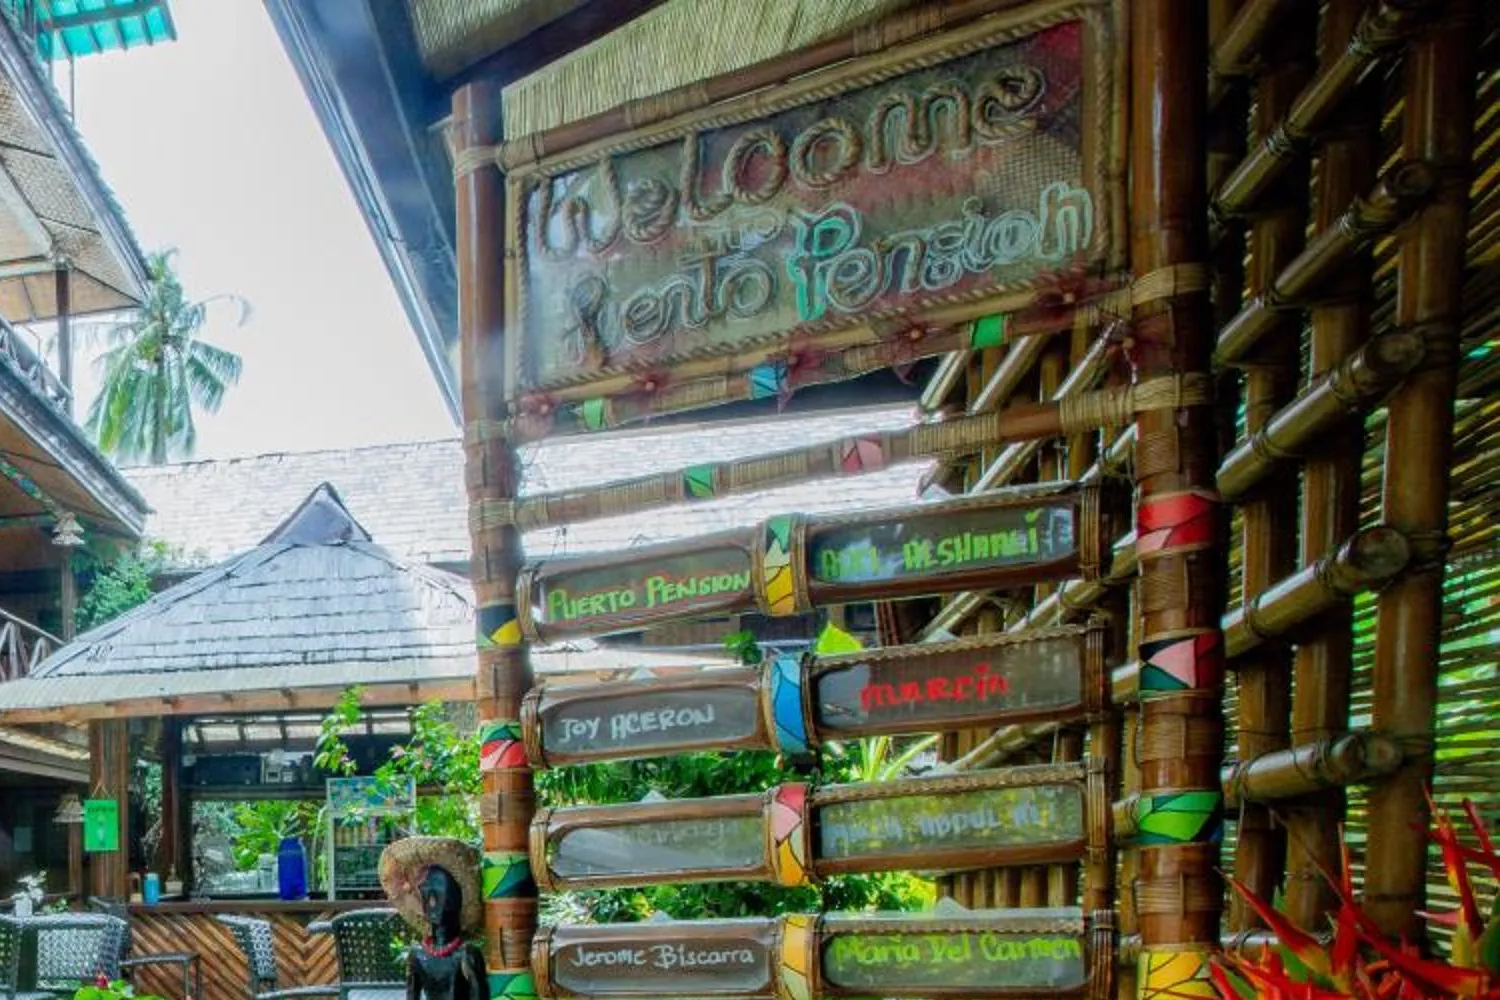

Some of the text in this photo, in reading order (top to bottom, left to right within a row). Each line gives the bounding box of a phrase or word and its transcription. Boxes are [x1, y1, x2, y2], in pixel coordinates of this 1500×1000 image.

[537, 66, 1044, 260] Welcome
[786, 182, 1094, 321] Pension
[548, 571, 750, 622] PUERTO PENSION
[558, 704, 715, 743] JOY ACERON
[571, 944, 755, 968] Jerome Biscarra
